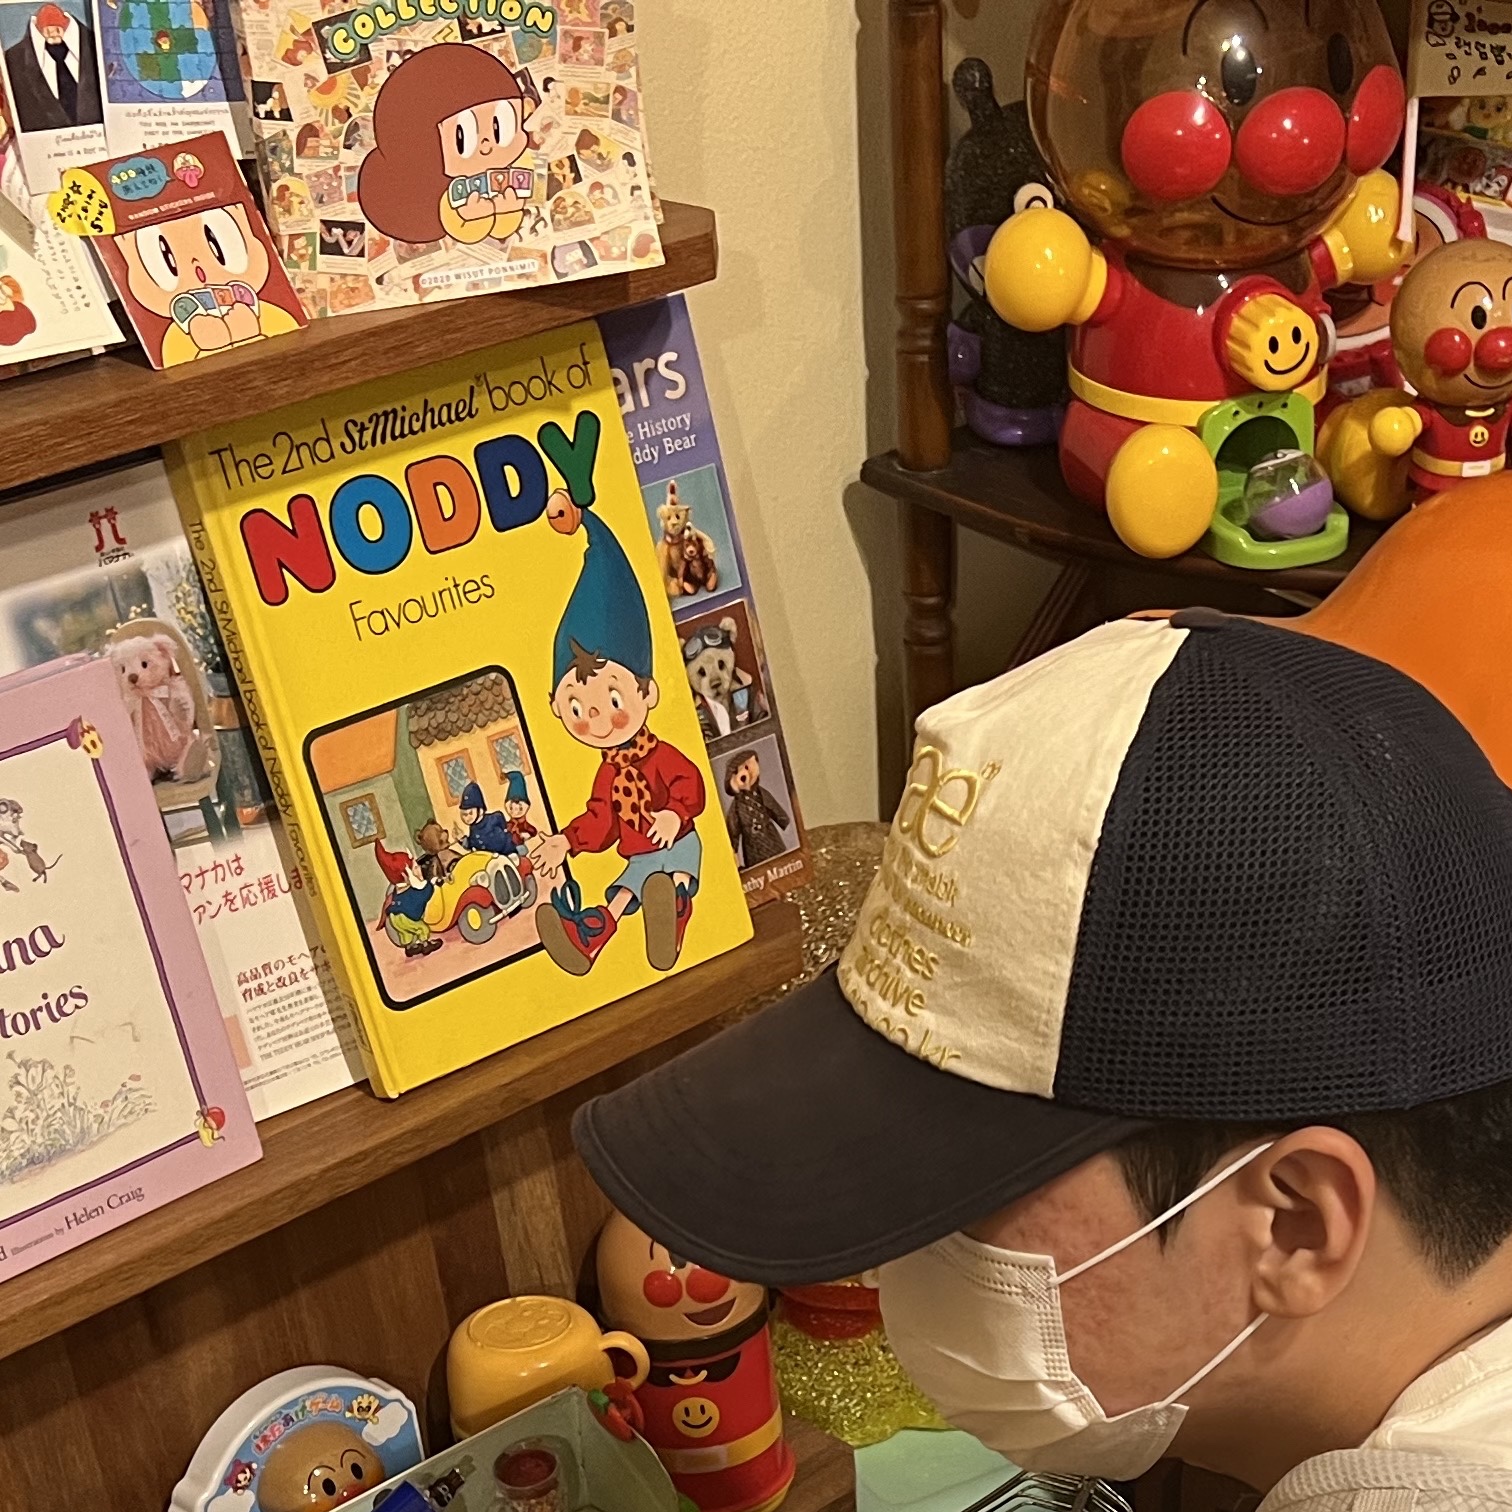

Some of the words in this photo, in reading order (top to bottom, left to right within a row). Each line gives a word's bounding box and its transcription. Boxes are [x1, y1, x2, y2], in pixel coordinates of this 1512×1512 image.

[208, 443, 275, 491] The
[273, 418, 336, 476] 2nd
[483, 356, 565, 412] book
[567, 342, 593, 390] of
[637, 412, 692, 441] History
[662, 434, 697, 456] Bear
[239, 408, 602, 608] NODDY
[349, 567, 498, 643] Favourites
[189, 521, 206, 551] The
[200, 558, 223, 594] 2nd
[243, 689, 268, 732] book
[265, 757, 293, 818] Noddy
[766, 859, 805, 883] Martin
[64, 1205, 105, 1230] Helen
[106, 1186, 145, 1210] Craig
